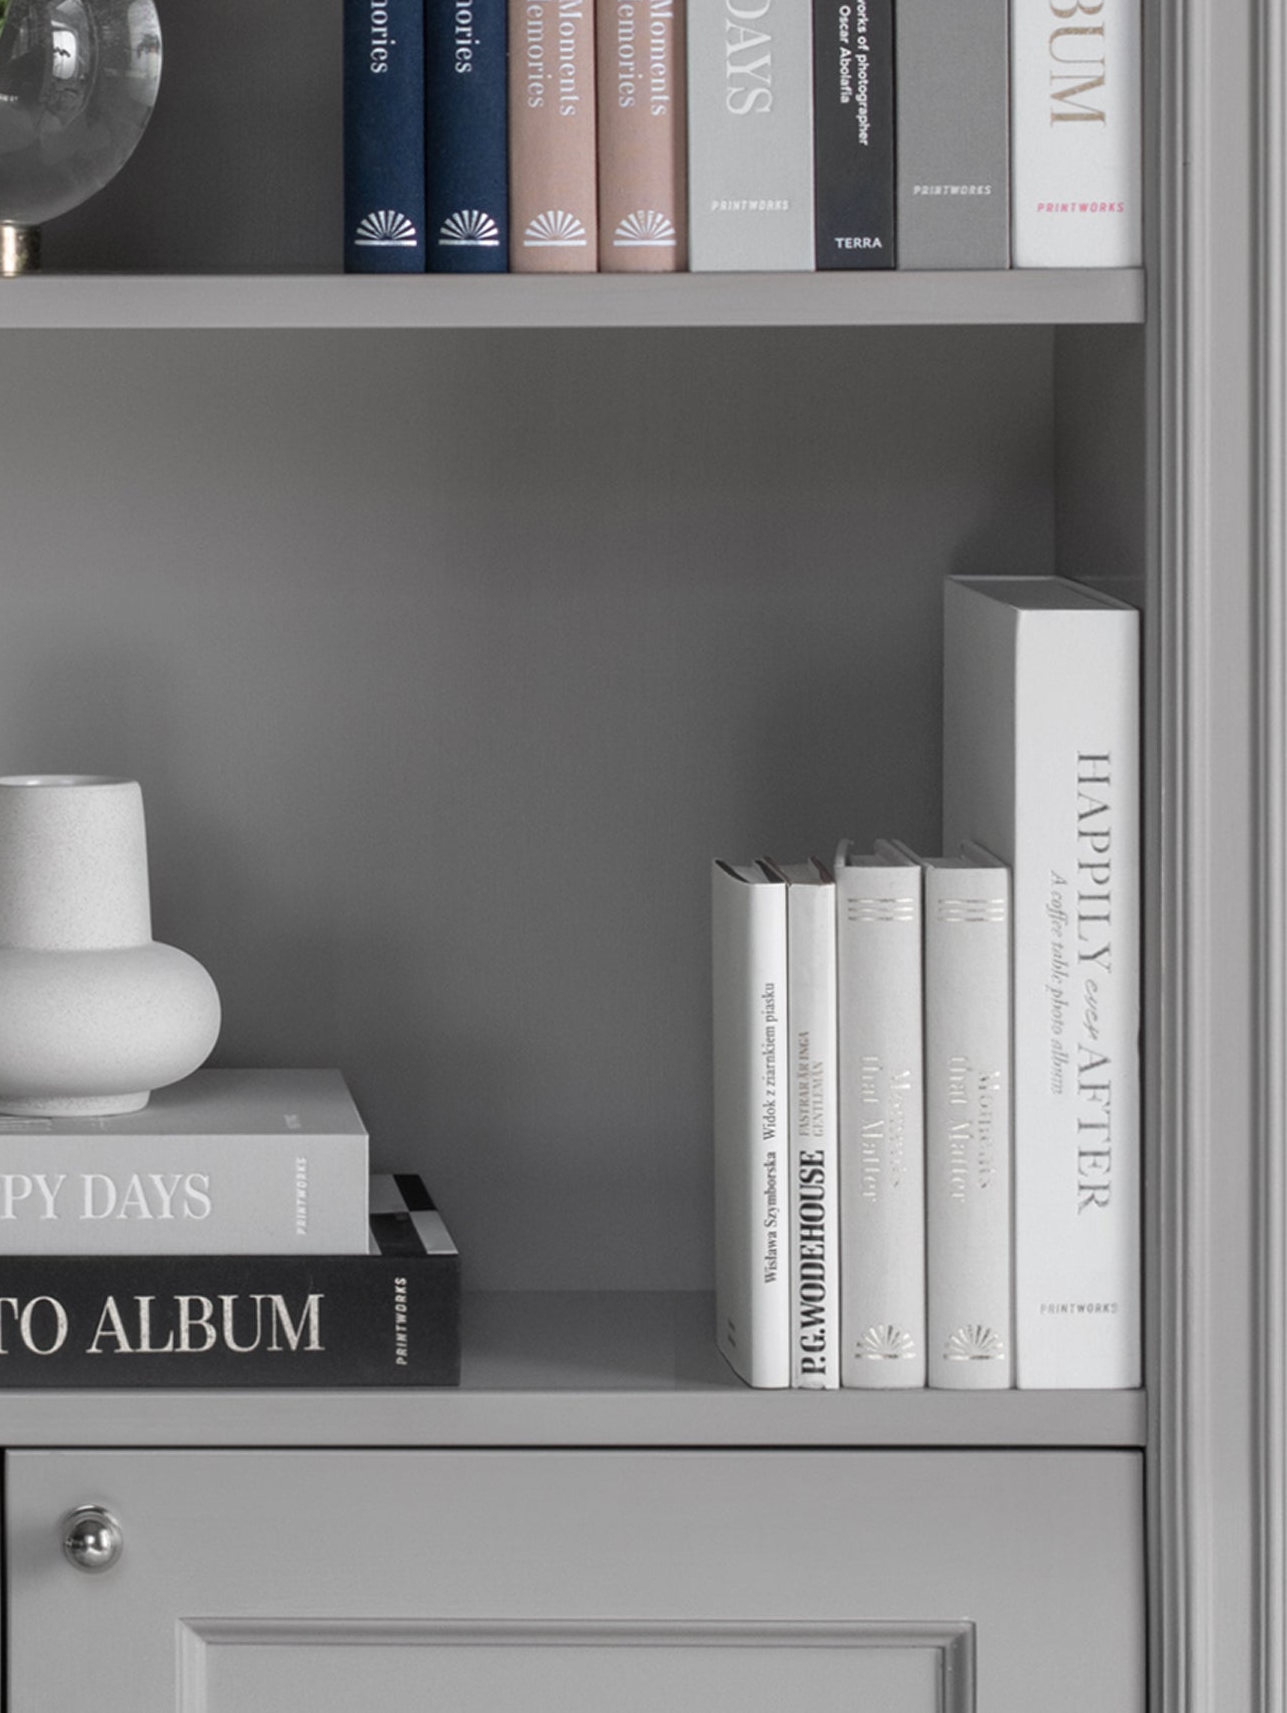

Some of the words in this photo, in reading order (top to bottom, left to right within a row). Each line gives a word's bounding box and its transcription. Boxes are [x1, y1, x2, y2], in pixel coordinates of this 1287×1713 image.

[839, 5, 851, 43] Oscar
[857, 36, 869, 51] of
[560, 0, 582, 115] Moments
[840, 47, 852, 103] Abolafia
[855, 54, 870, 145] photographer
[835, 238, 882, 248] TERRA
[1051, 870, 1068, 885] A
[1076, 751, 1112, 974] HAPPILY
[1046, 891, 1068, 937] coffee
[1052, 941, 1069, 983] table
[762, 983, 777, 1022] piasku
[1046, 986, 1069, 1035] photo
[1082, 977, 1105, 1041] ever
[762, 1026, 775, 1087] ziarnkiem
[1052, 1039, 1069, 1095] album
[763, 1100, 776, 1140] Widok
[1076, 1043, 1112, 1216] AFTER
[80, 1174, 210, 1219] DAYS
[763, 1152, 779, 1227] Szymborska
[86, 1294, 324, 1353] ALBUM
